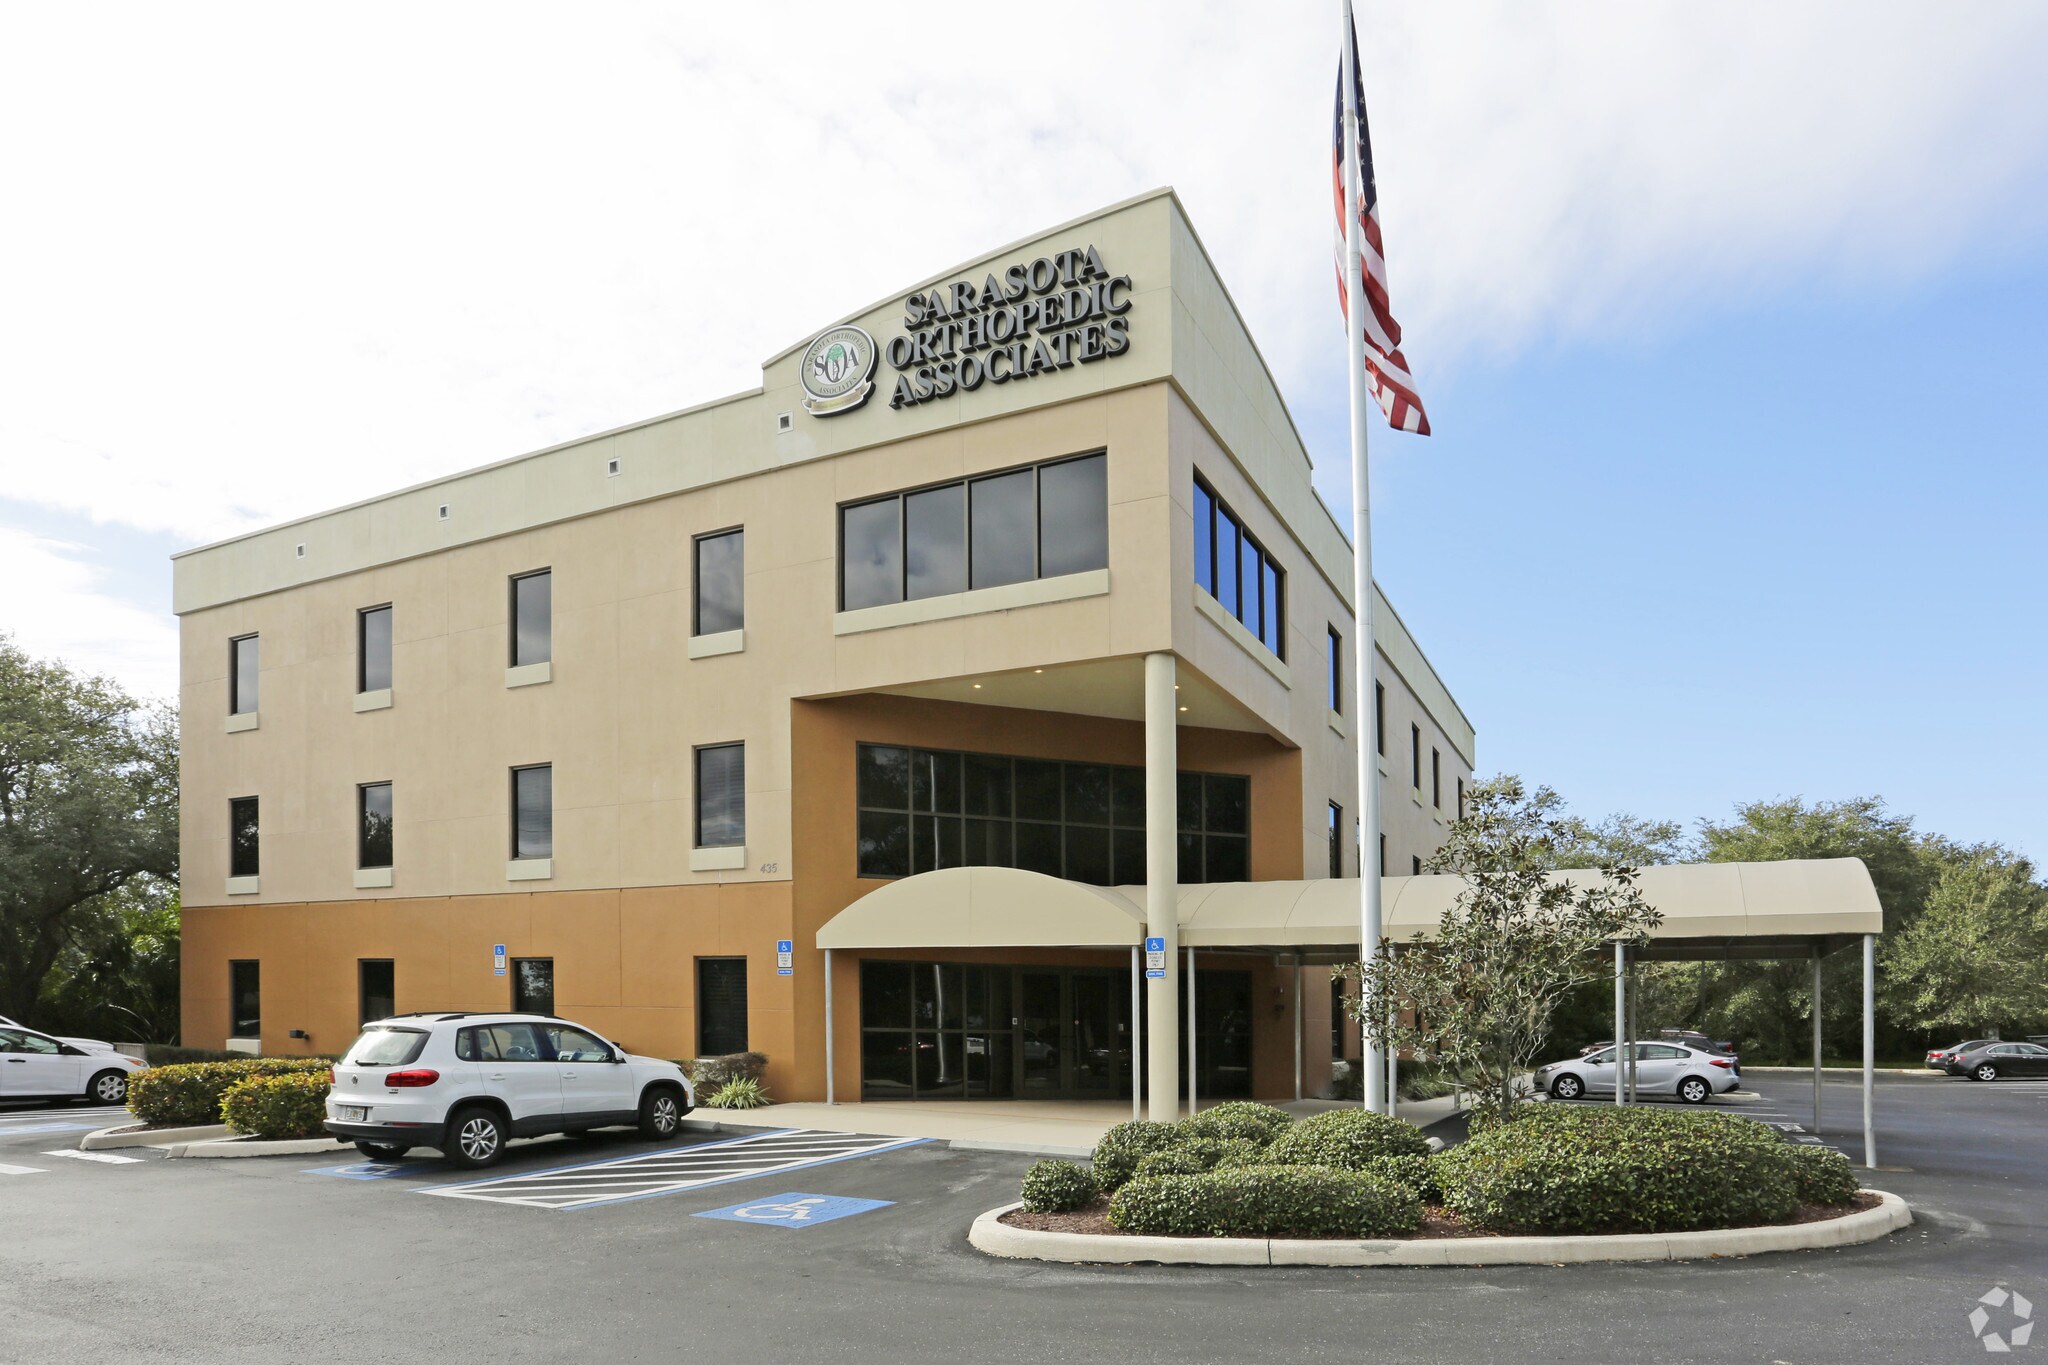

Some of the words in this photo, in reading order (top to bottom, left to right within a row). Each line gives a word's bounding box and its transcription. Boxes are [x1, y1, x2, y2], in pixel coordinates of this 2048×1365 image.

[904, 244, 1110, 330] SARASOTA
[886, 274, 1132, 371] ORTHOPEDIC
[814, 343, 860, 383] SOA
[831, 333, 865, 353] ORTHOPEDIC
[888, 316, 1131, 410] ASSOCIATES
[819, 376, 858, 394] ASSOCIATES
[760, 863, 778, 874] 435
